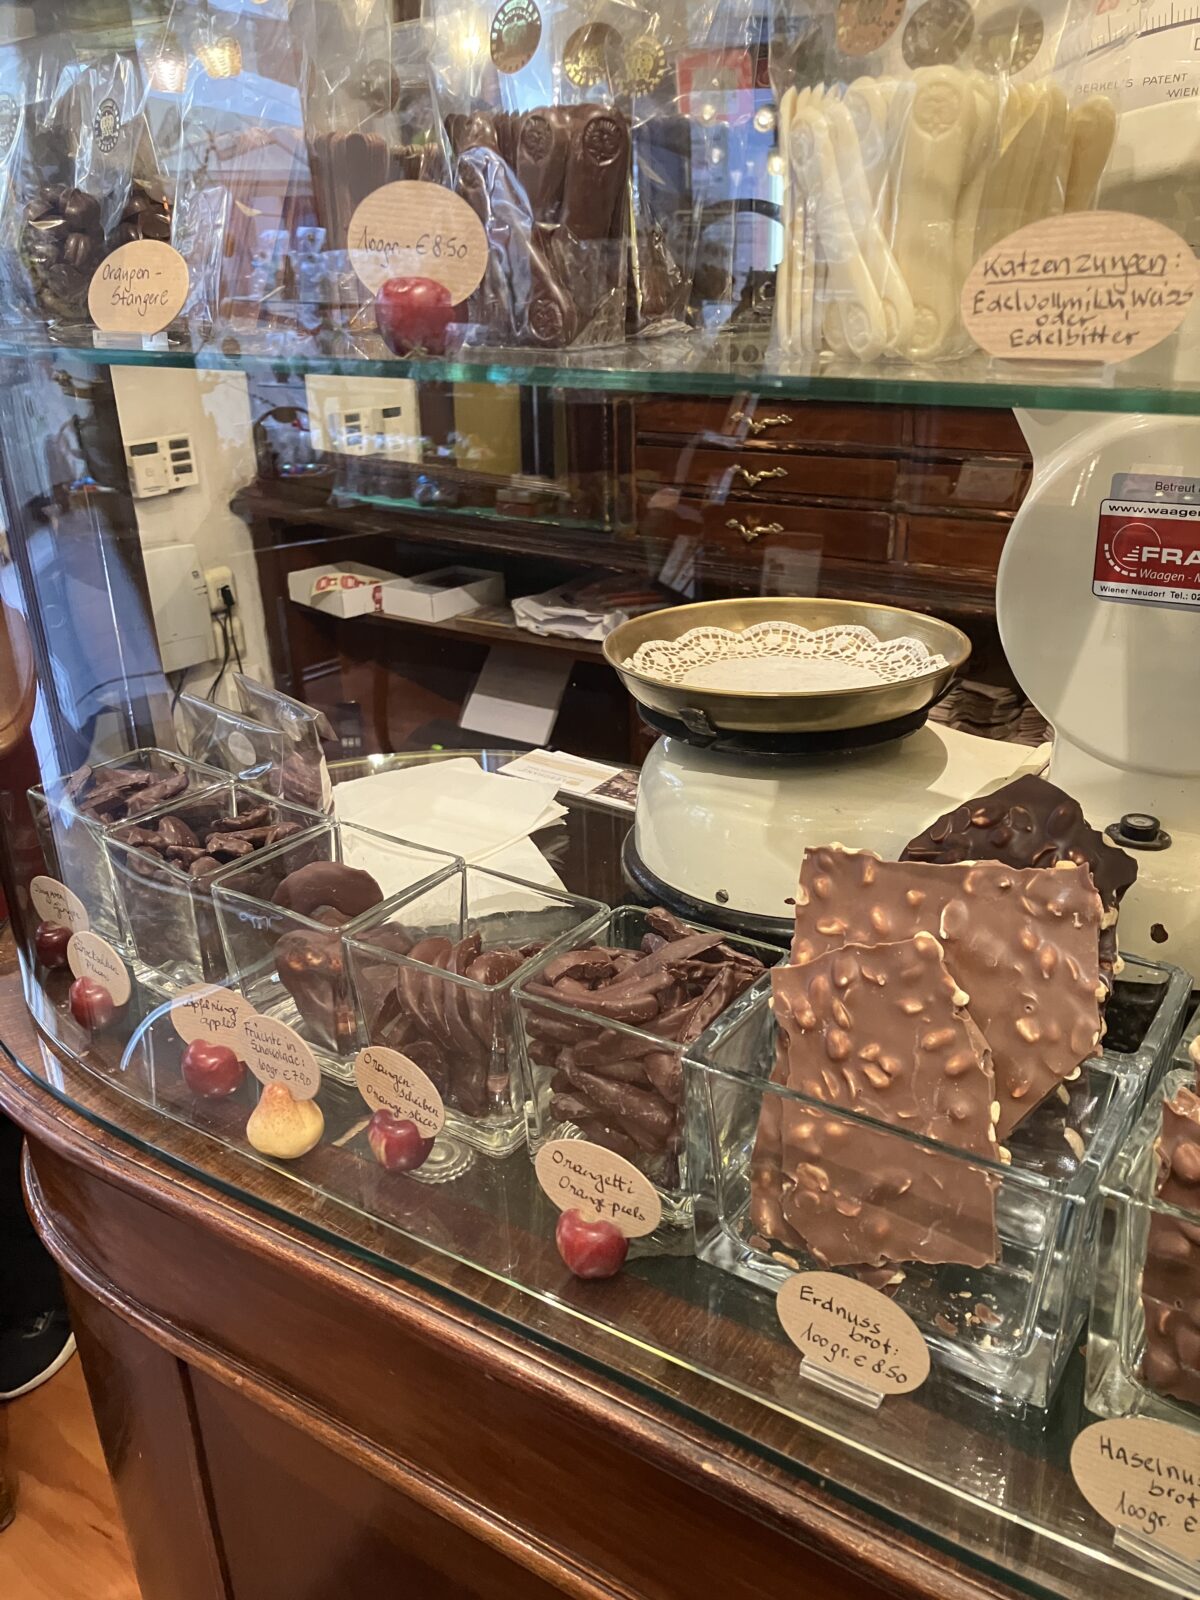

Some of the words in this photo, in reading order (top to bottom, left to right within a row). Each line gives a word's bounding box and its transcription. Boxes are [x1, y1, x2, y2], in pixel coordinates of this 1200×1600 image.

[1142, 72, 1188, 87] PATENT
[1035, 308, 1097, 327] oder
[1009, 325, 1140, 348] Edelbitter
[1155, 481, 1195, 493] Betreut
[1108, 504, 1200, 517] www.waage
[1141, 546, 1200, 566] FRA
[1139, 567, 1185, 583] Waagen
[1100, 585, 1129, 595] Wiener
[1131, 588, 1166, 598] Neudorf
[1170, 590, 1188, 600] Tel.:
[552, 1150, 636, 1194] Orangetti
[799, 1285, 881, 1335] Erdnuss
